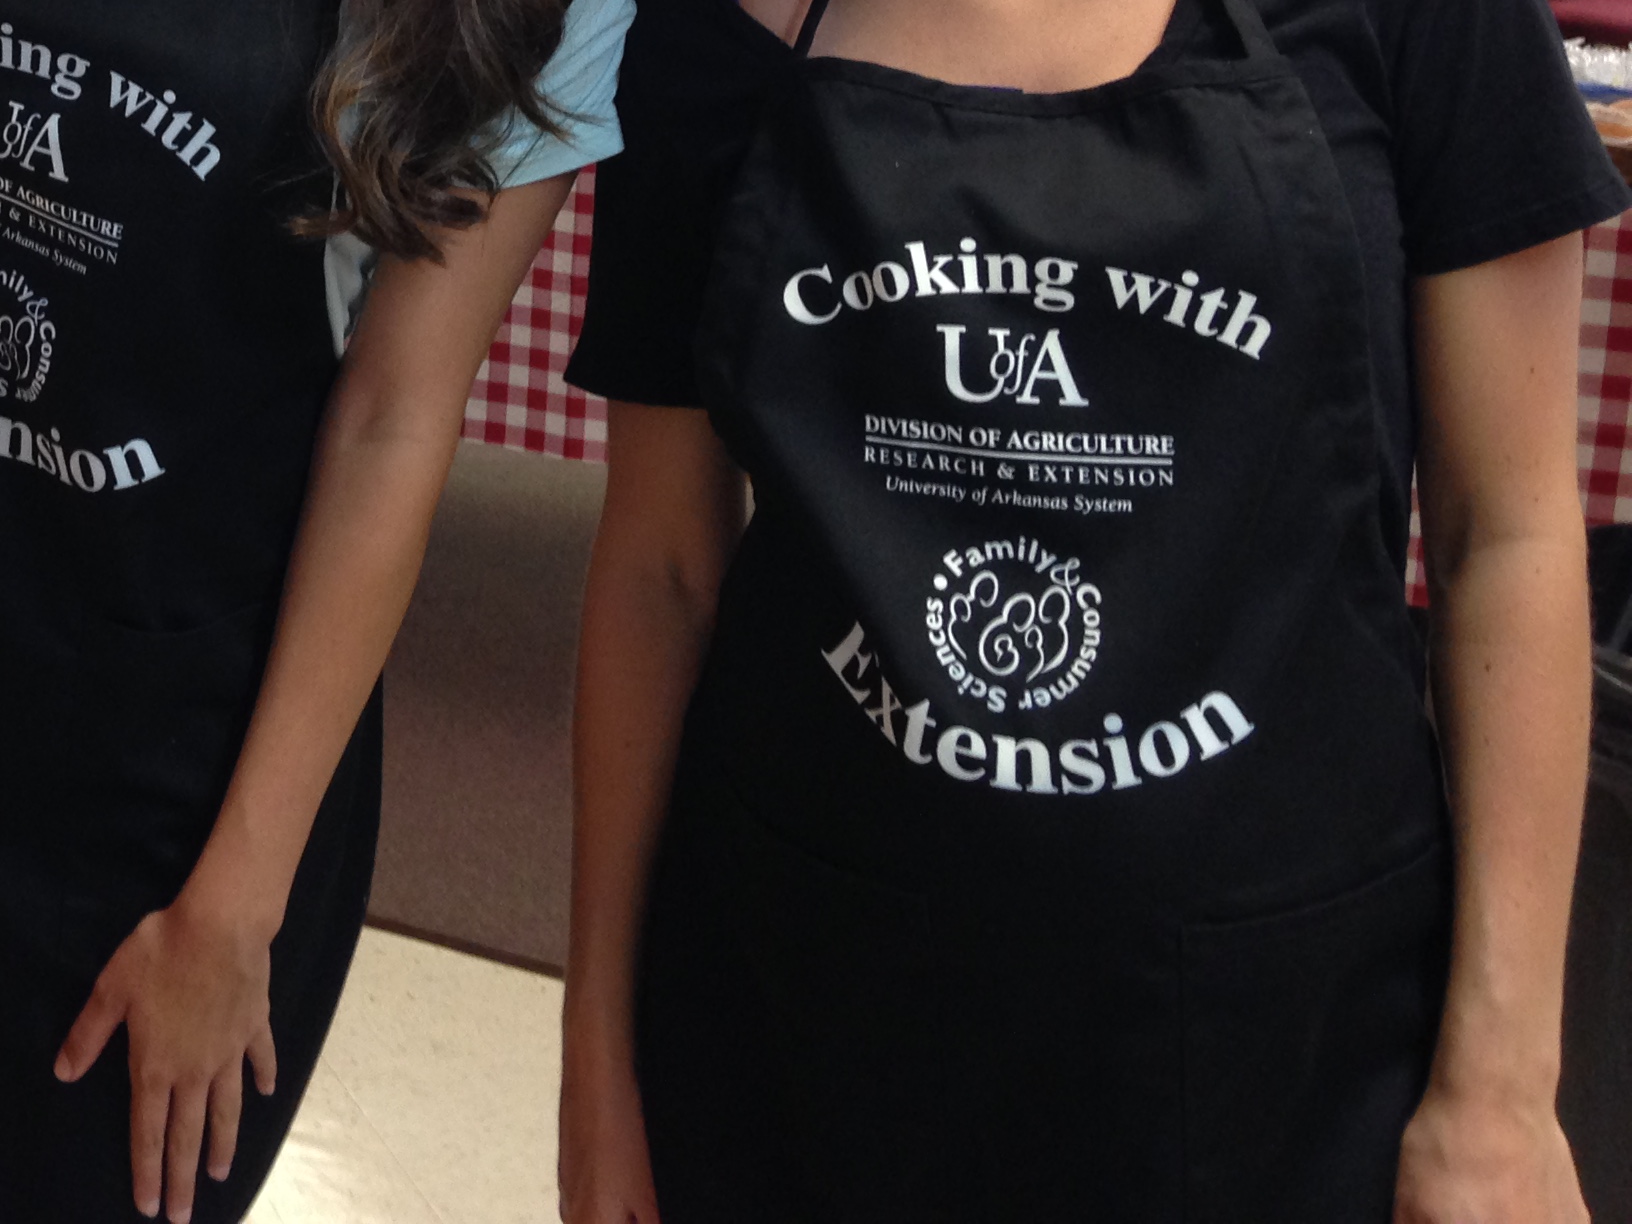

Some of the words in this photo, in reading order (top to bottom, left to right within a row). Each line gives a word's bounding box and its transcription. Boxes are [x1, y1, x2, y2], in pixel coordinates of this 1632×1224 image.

[109, 69, 222, 181] with
[9, 207, 21, 222] &
[28, 215, 118, 265] EXTENSION
[16, 183, 124, 241] AGRICULTURE
[3, 225, 50, 260] Arkansas
[51, 246, 88, 275] System
[783, 237, 1078, 326] Cooking
[1105, 266, 1272, 360] with
[15, 320, 56, 402] Consumer
[865, 413, 963, 445] DIVISION
[969, 427, 1001, 449] OF
[1007, 430, 1175, 456] AGRICULTURE
[864, 446, 986, 478] RESEARCH
[996, 463, 1015, 480] &
[1028, 465, 1175, 487] EXTENSION
[885, 475, 967, 503] University
[972, 484, 989, 507] of
[992, 488, 1069, 511] Arkansas
[1074, 493, 1134, 514] System
[943, 536, 1058, 580] Family
[1050, 557, 1081, 590] &
[925, 595, 1008, 714] Sciences
[1018, 583, 1103, 712] Consumer
[821, 620, 1256, 796] Extension
